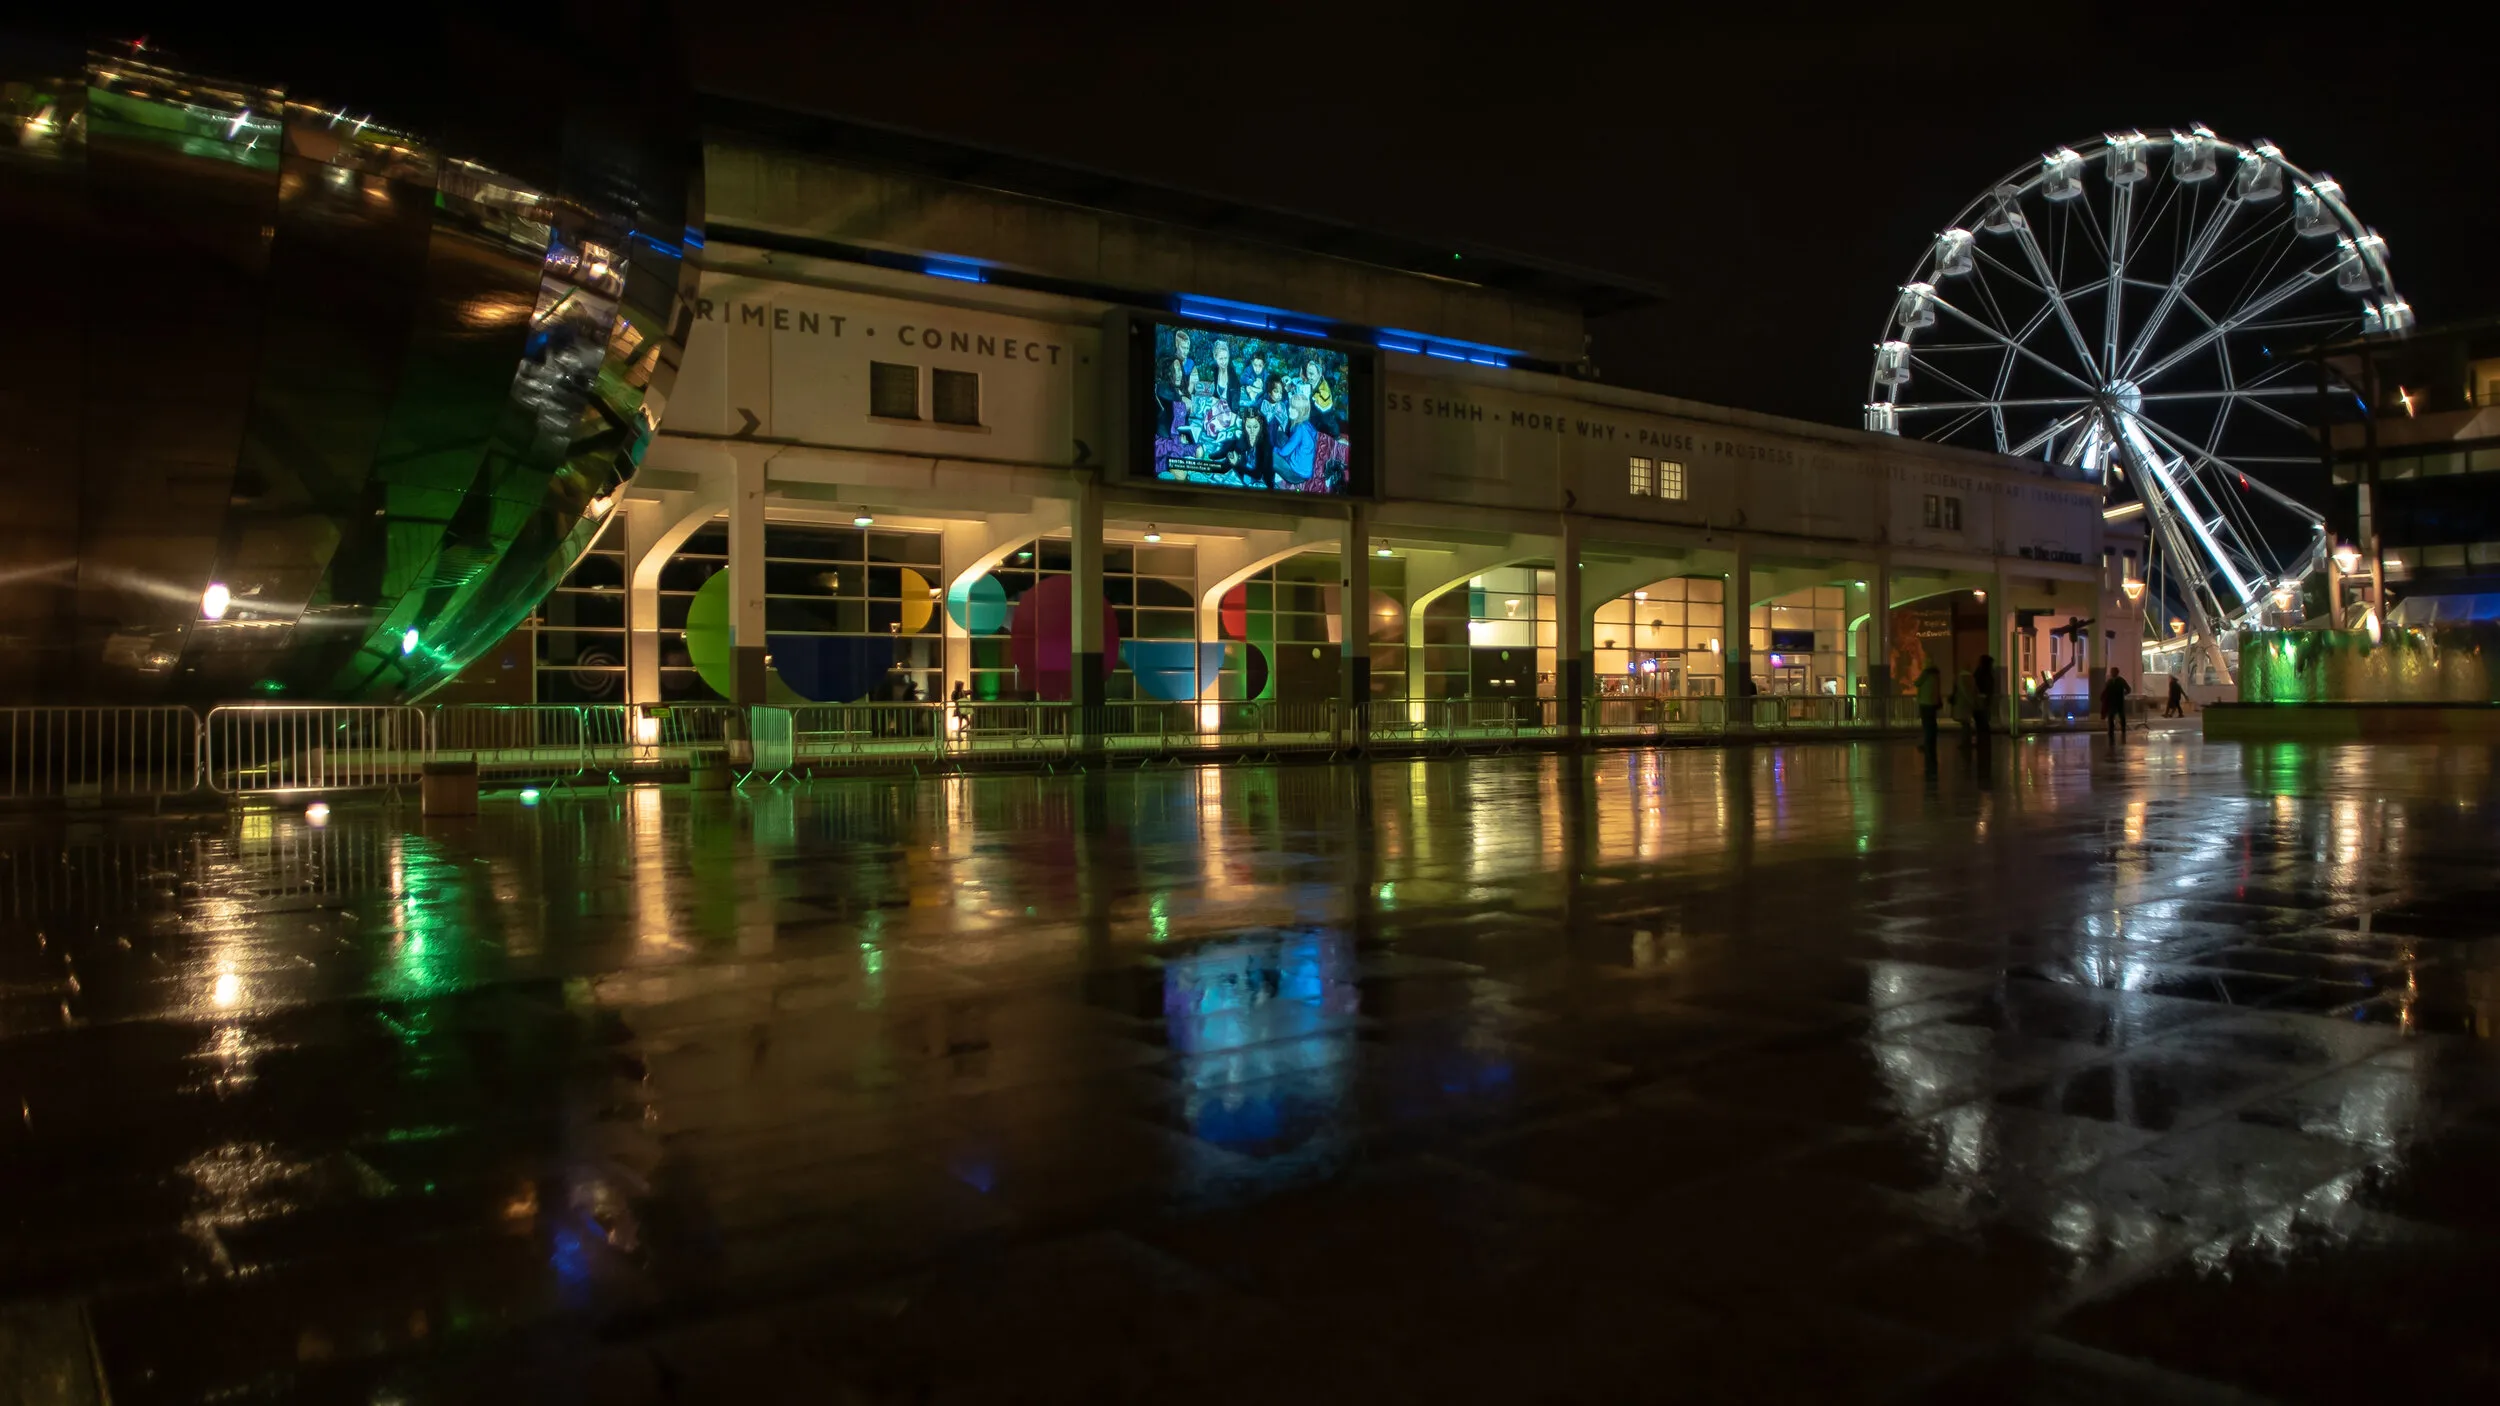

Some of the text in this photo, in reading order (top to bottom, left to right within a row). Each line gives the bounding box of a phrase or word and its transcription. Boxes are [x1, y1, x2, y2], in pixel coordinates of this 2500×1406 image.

[897, 325, 1062, 365] CONNECT
[1423, 398, 1483, 422] SHHH
[1511, 410, 1566, 434] MORE
[1576, 420, 1615, 440] WHY
[1638, 430, 1694, 452] PAUSE
[1922, 472, 1972, 492] SCIENCE
